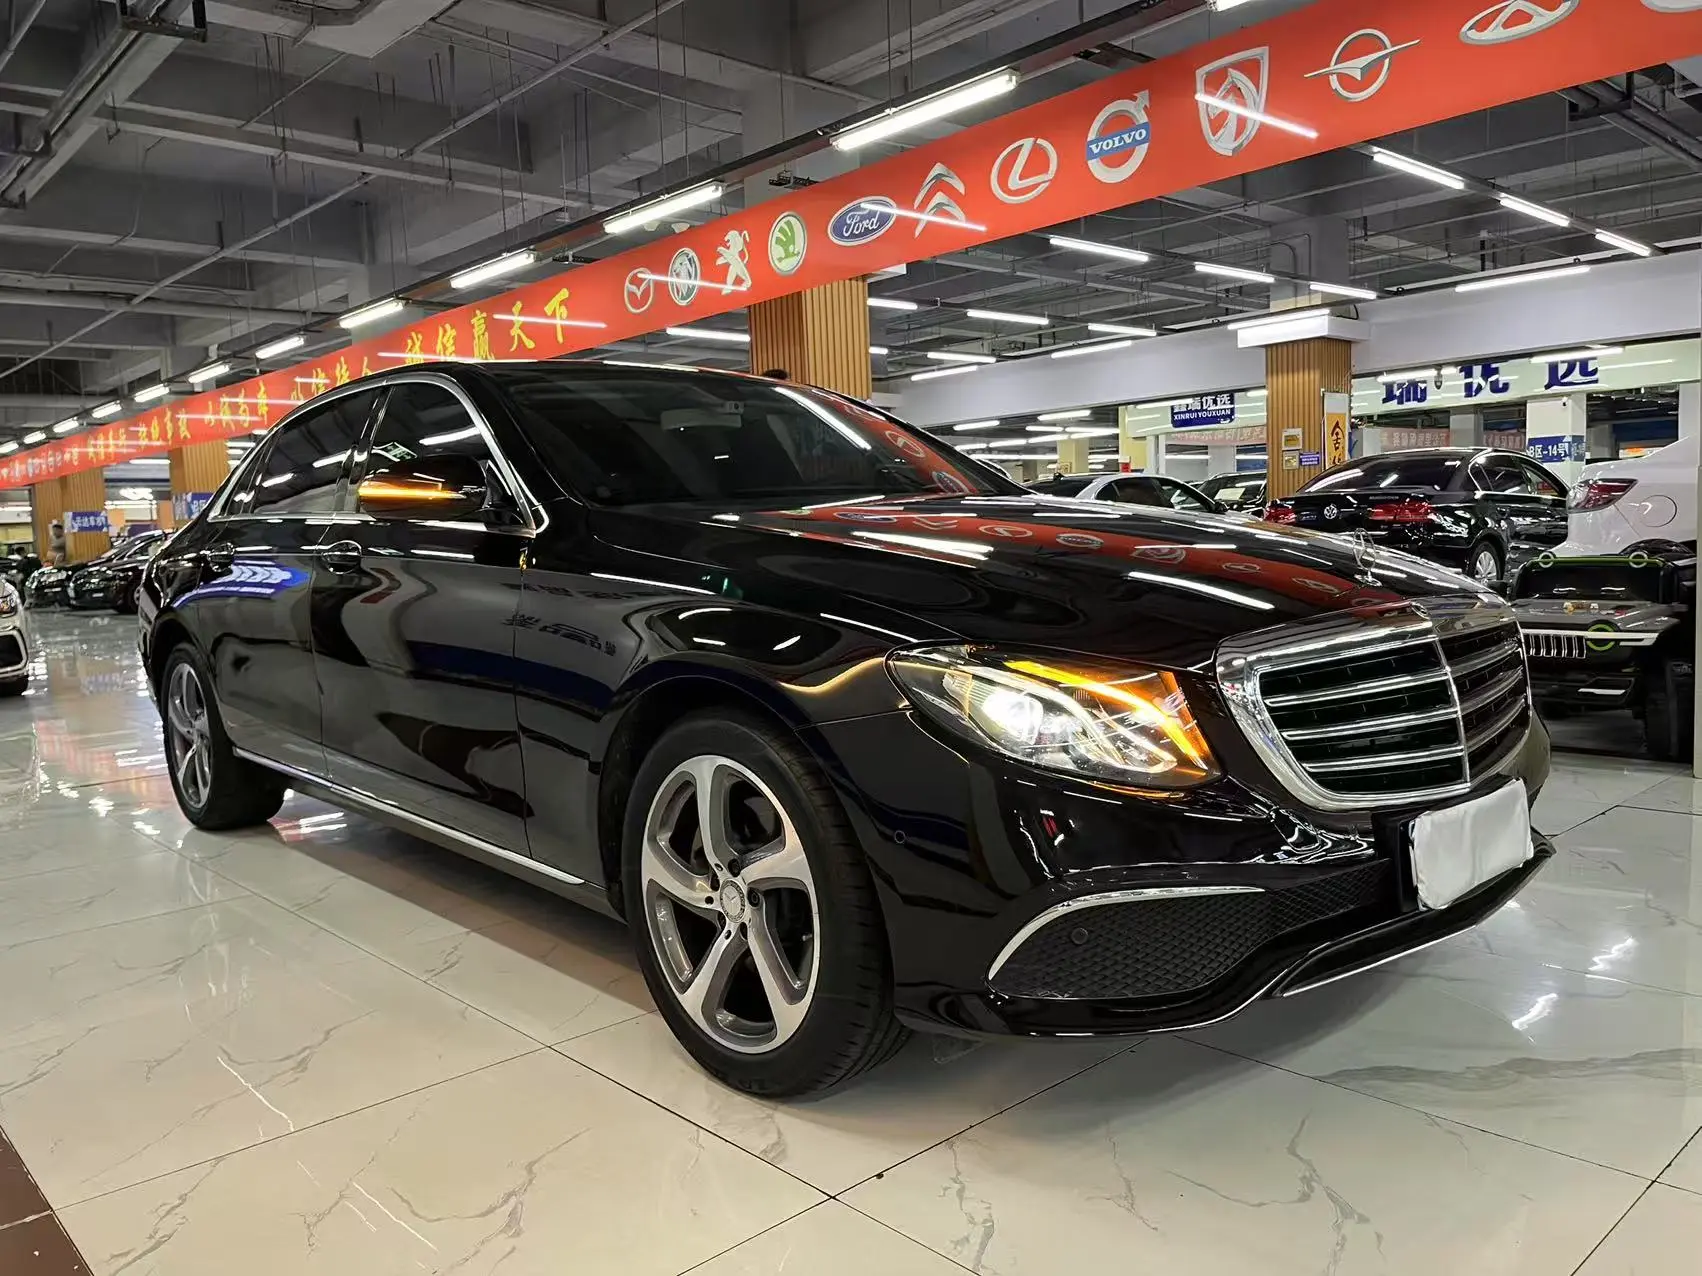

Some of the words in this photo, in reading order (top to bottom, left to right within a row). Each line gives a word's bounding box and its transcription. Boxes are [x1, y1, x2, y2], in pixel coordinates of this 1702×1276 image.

[1089, 129, 1147, 154] VOLVO
[843, 206, 880, 237] Ford
[405, 288, 569, 364] 诚信赢天下
[1174, 412, 1197, 420] XINRUI
[1198, 409, 1231, 418] YOUXUAN
